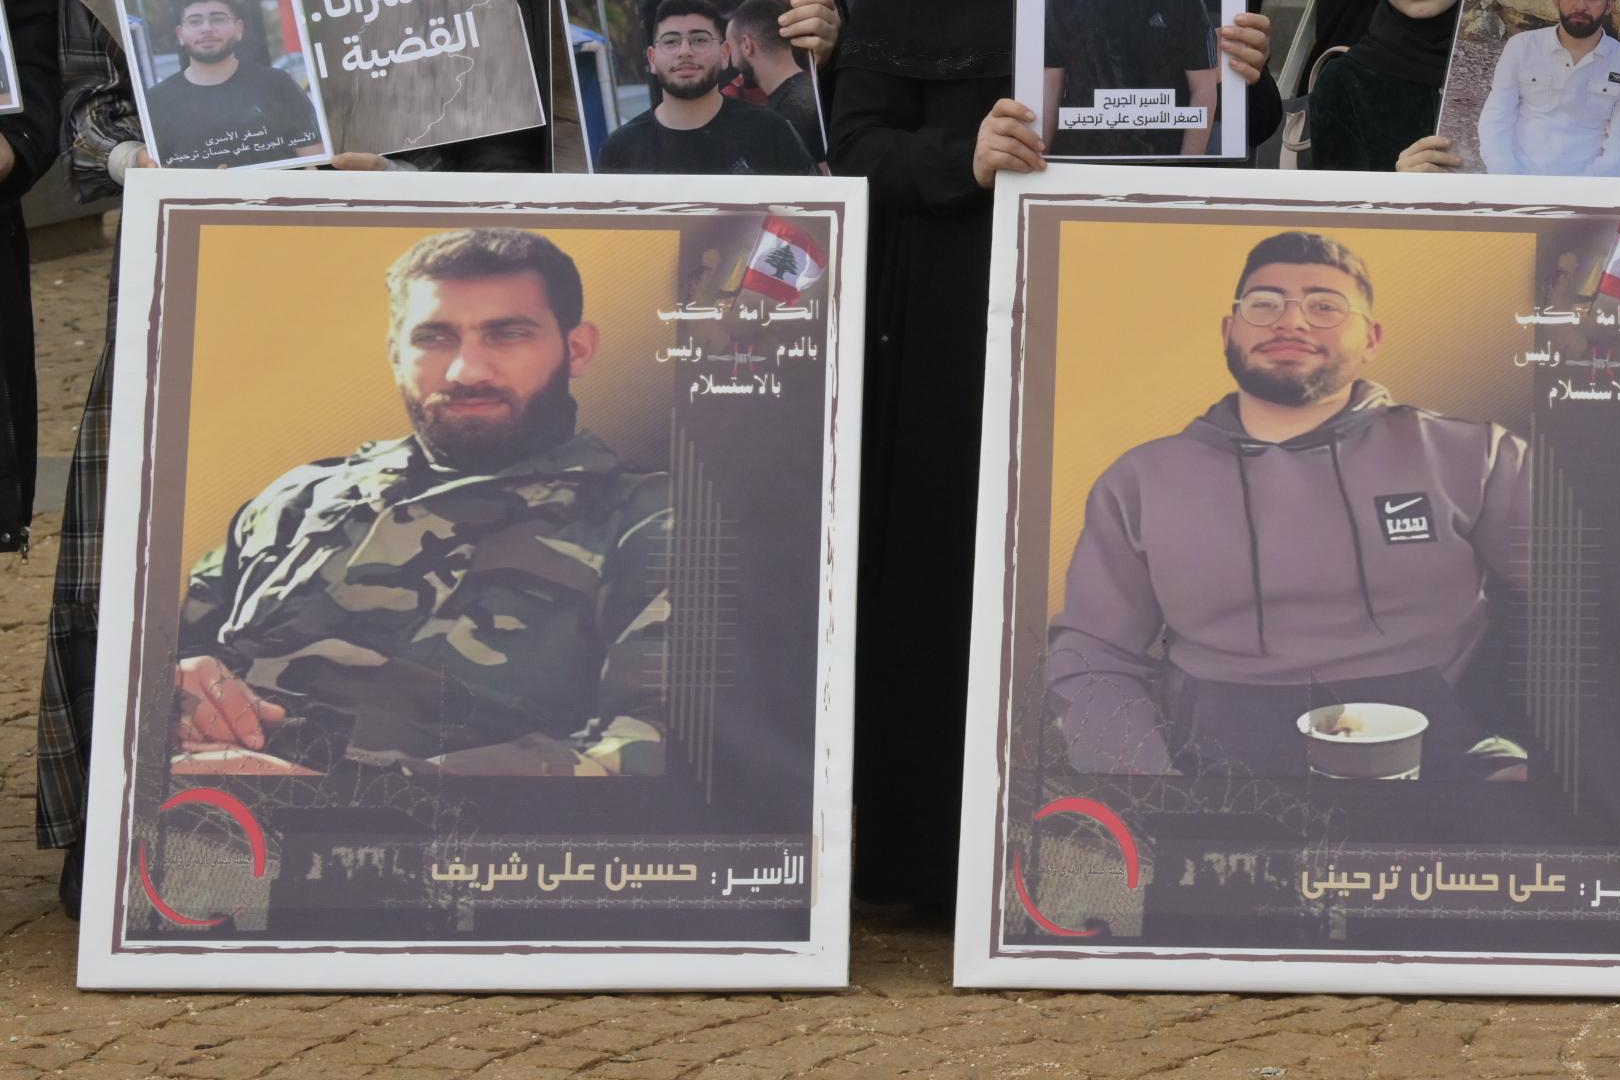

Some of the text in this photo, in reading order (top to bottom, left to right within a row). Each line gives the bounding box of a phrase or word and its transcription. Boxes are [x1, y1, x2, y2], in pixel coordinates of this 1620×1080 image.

[342, 11, 479, 78] القضية
[1103, 93, 1170, 110] الأسير الجريح
[1064, 109, 1202, 129] أصغر الأسرى علي ترحيني
[657, 299, 819, 326] الكرامة تكتب
[1514, 305, 1581, 329] تكتب
[656, 336, 818, 366] بالدم وليس
[1513, 341, 1560, 367] وليس
[690, 373, 781, 403] بالاستسلام
[431, 851, 528, 892] شريف
[605, 856, 697, 891] حسين
[1410, 861, 1499, 901] حسان
